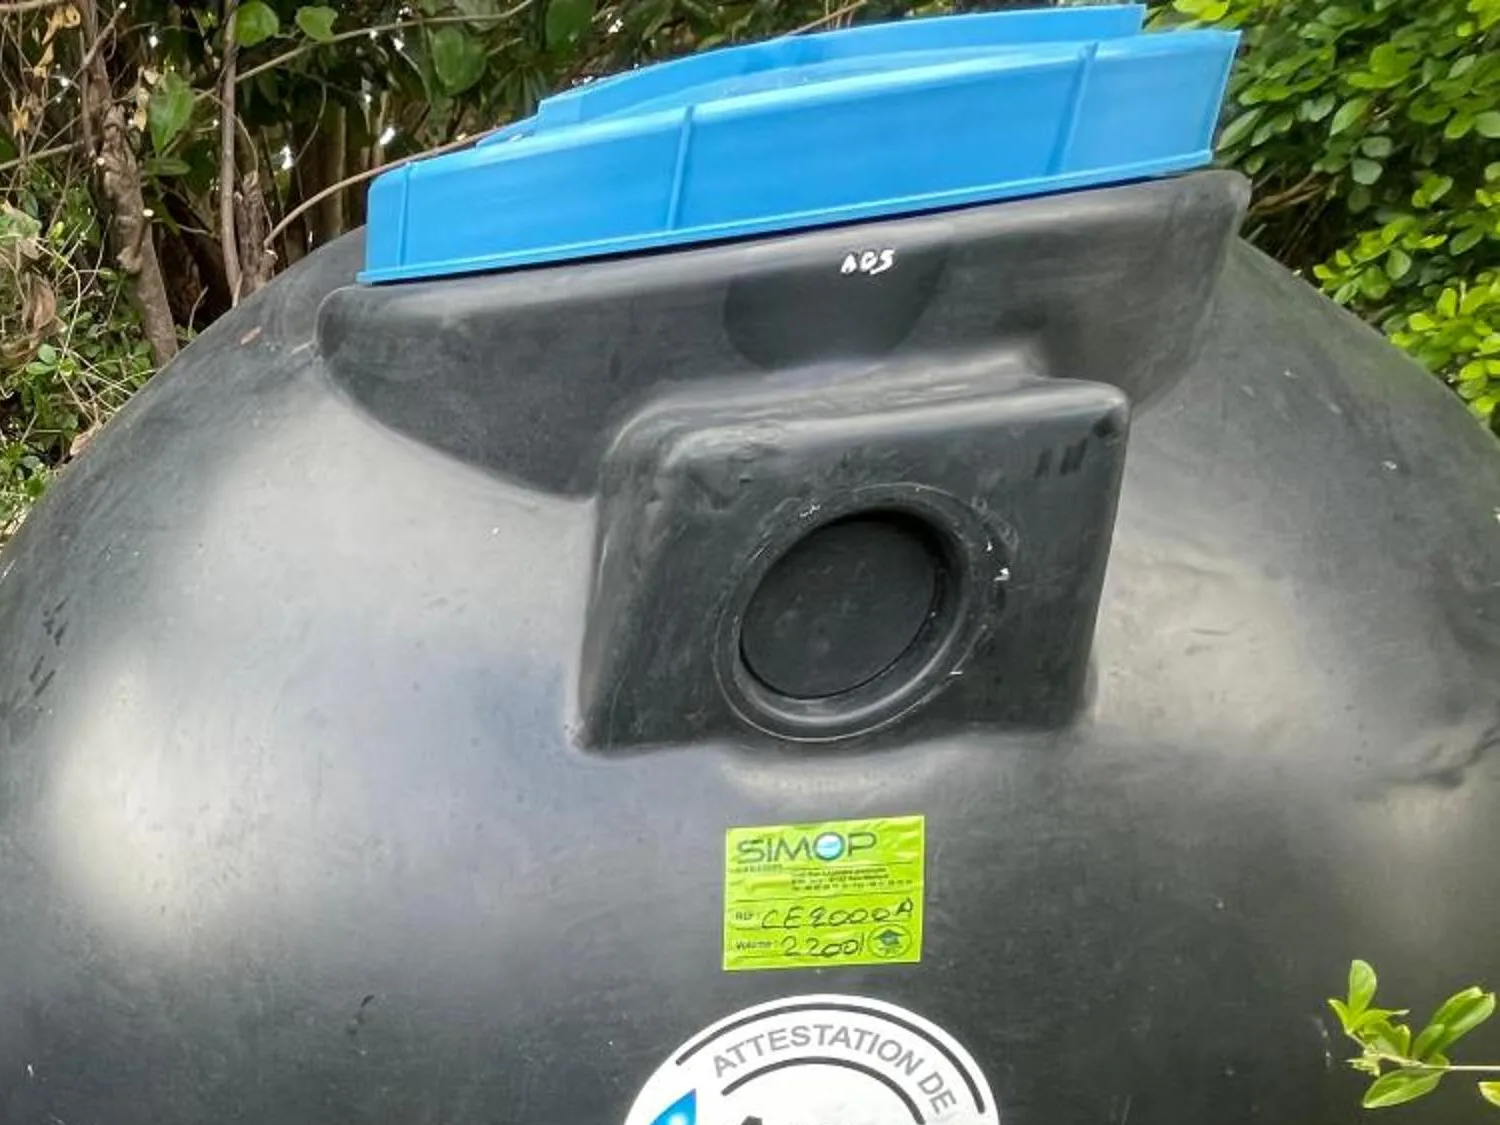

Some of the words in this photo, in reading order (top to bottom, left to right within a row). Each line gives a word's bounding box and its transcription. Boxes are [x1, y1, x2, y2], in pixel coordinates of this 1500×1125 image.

[736, 832, 877, 863] SIMOP
[713, 1023, 924, 1079] ATTESTATION
[916, 1071, 957, 1114] DE
